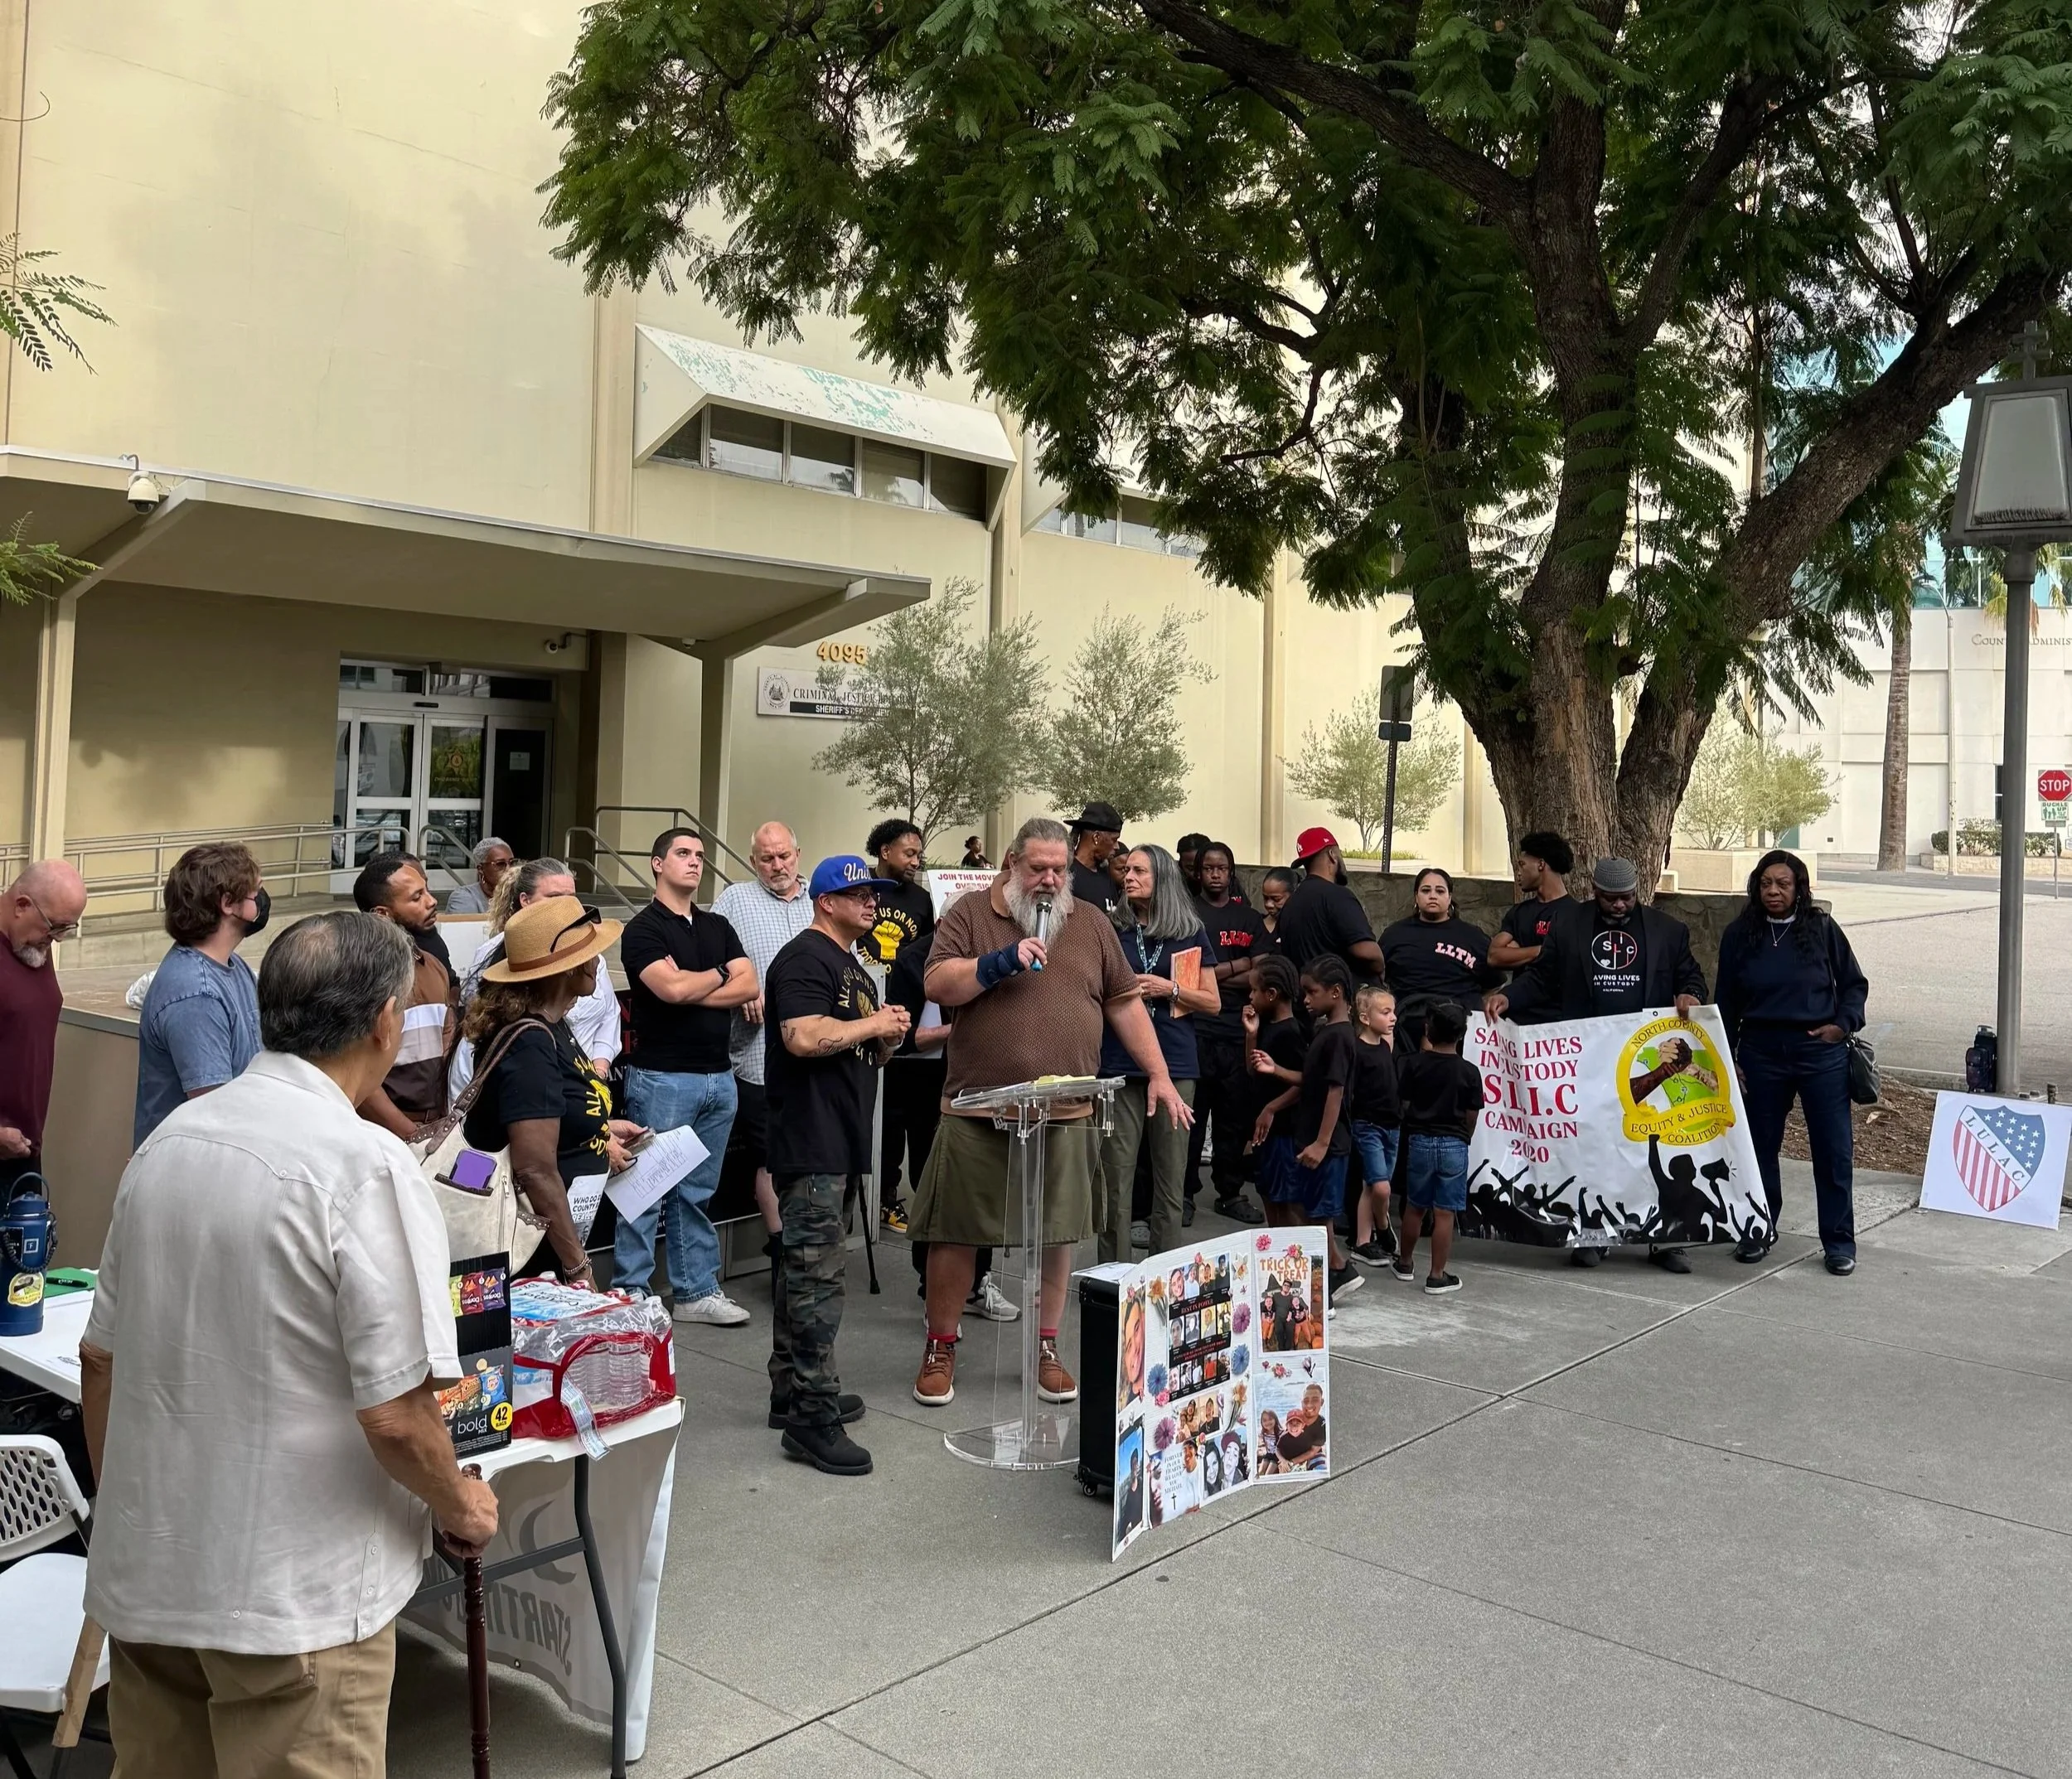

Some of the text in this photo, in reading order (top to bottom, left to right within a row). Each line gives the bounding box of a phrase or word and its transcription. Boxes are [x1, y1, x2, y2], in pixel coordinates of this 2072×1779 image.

[1972, 633, 2005, 645] COUN
[816, 642, 868, 665] 4095
[816, 704, 850, 715] SHERIFF'S
[2040, 780, 2070, 791] STOP
[879, 907, 891, 917] US
[893, 910, 907, 922] OR
[1435, 942, 1477, 969] LLTM
[838, 986, 850, 1008] ALL
[1631, 1019, 1706, 1047] NORTH COUNTY
[1524, 1036, 1582, 1059] LIVES
[1479, 1050, 1500, 1070] IN
[586, 1091, 602, 1117] ALL
[1485, 1110, 1578, 1140] CAMAIGN
[1631, 1103, 1728, 1134] EQUITY & JUSTICE
[1668, 1122, 1721, 1143] COALITION
[1511, 1139, 1549, 1163] 2020
[1965, 1115, 2026, 1182] LULAC
[573, 1203, 596, 1213] COUNTY
[574, 1196, 589, 1205] WHO
[589, 1195, 598, 1203] DO
[1260, 1256, 1309, 1271] TRICK OR
[1277, 1269, 1309, 1282] TREAT
[457, 1414, 487, 1434] bold
[495, 1406, 508, 1422] 42
